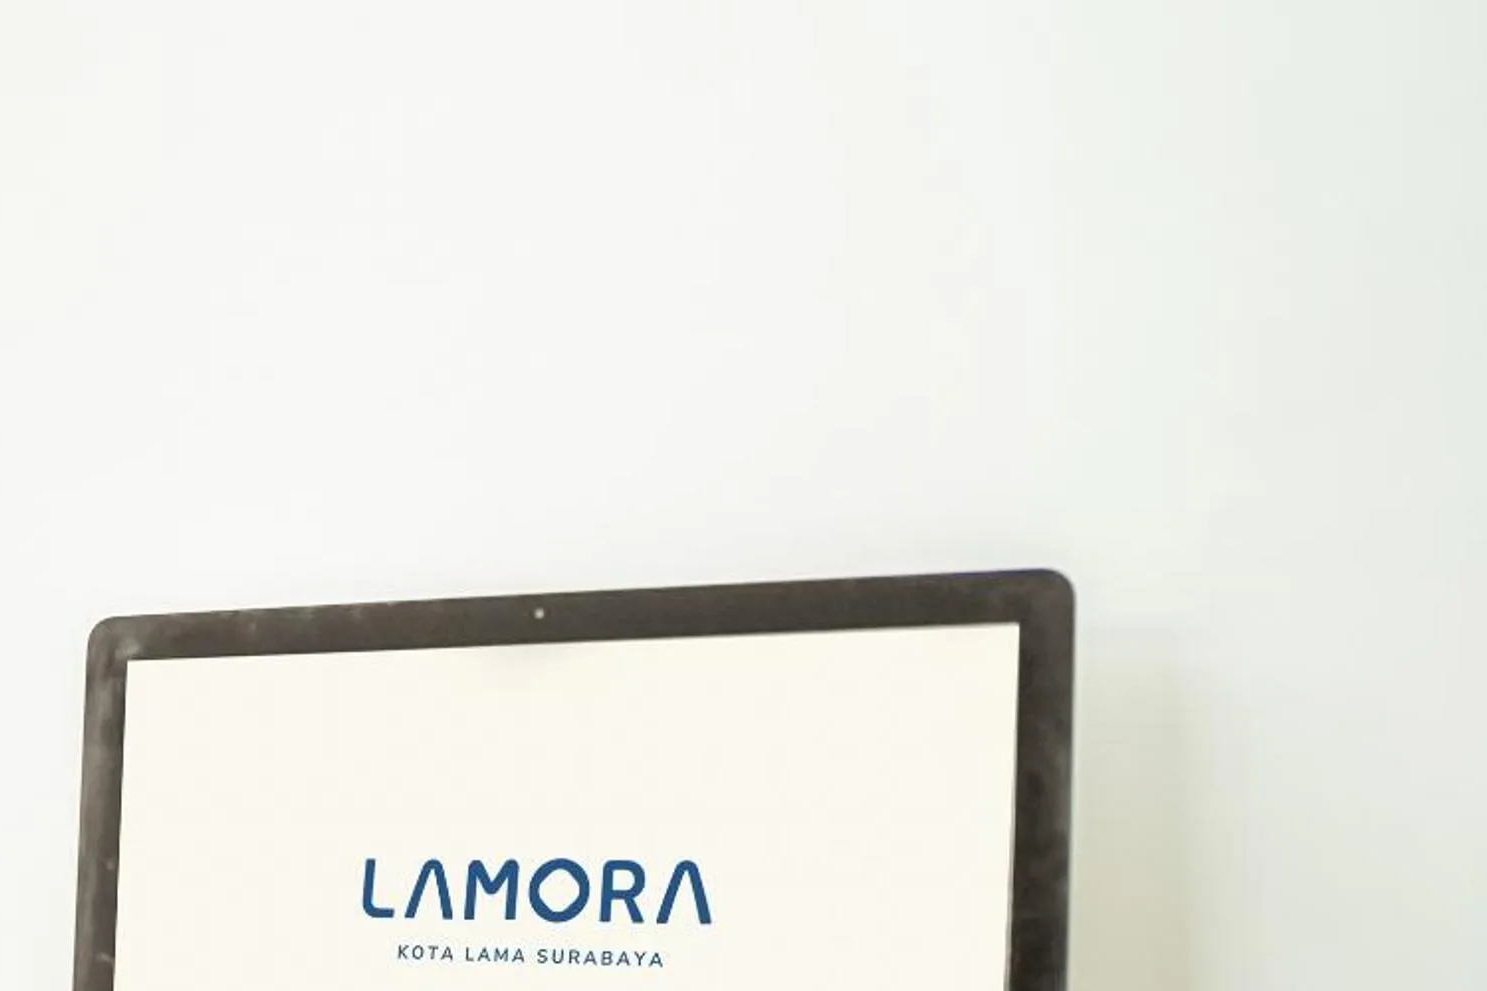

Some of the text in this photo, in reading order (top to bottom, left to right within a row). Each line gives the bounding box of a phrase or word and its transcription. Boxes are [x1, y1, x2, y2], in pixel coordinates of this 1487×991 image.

[361, 857, 713, 925] LAMORA
[397, 944, 664, 968] KOTA LAMA SURABAYA
